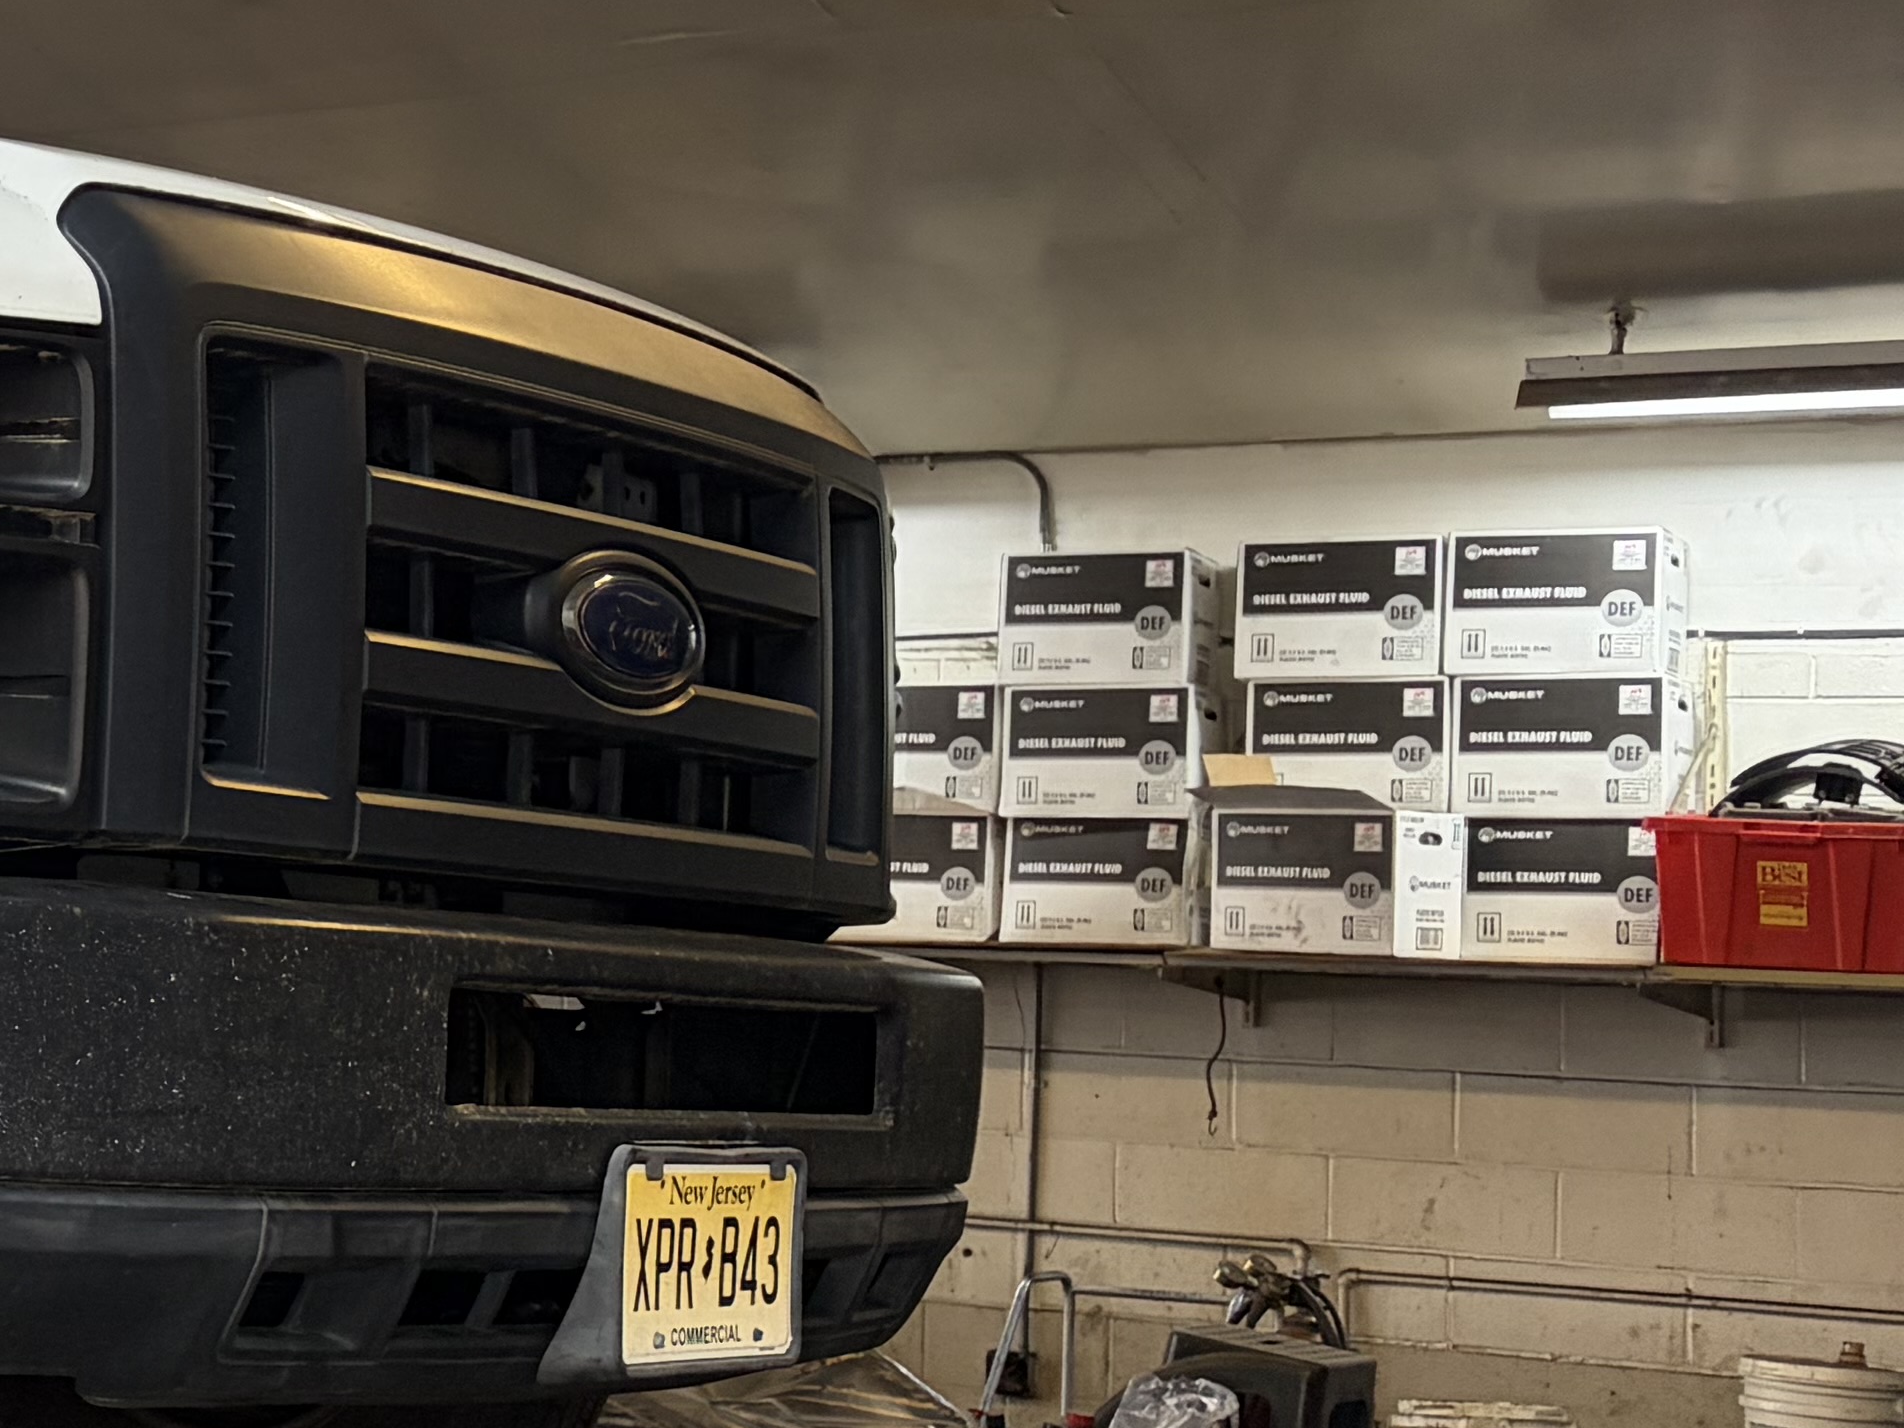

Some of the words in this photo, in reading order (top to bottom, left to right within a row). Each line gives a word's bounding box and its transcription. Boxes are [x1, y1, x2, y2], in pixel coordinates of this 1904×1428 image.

[1253, 594, 1287, 605] DIESEL
[1289, 592, 1336, 604] EXHAUST
[1338, 592, 1370, 603] FLUID
[1463, 588, 1499, 599] DIESEL
[1501, 587, 1552, 598] EXHAUST
[1553, 587, 1587, 598] FLUID
[1014, 604, 1045, 615] DIESEL
[1047, 603, 1092, 615] EXHAUST
[1094, 603, 1122, 614] FLUID
[1390, 605, 1418, 620] DEF
[1607, 601, 1636, 616] DEF
[1140, 616, 1165, 630] DEF
[909, 733, 936, 744] FLUID
[1018, 738, 1049, 749] DIESEL
[1051, 737, 1095, 748] EXHAUST
[1097, 737, 1126, 748] FLUID
[1262, 733, 1295, 745] DIESEL
[1298, 733, 1345, 745] EXHAUST
[1347, 733, 1379, 744] FLUID
[1469, 732, 1504, 743] DIESEL
[1507, 731, 1557, 743] EXHAUST
[1559, 731, 1593, 743] FLUID
[953, 747, 976, 761] DEF
[1144, 751, 1170, 765] DEF
[1398, 747, 1426, 762] DEF
[1614, 746, 1643, 761] DEF
[902, 862, 929, 873] FLUID
[1018, 863, 1048, 873] DIESEL
[1049, 863, 1093, 874] EXHAUST
[1094, 863, 1123, 874] FLUID
[1226, 866, 1255, 877] DIESEL
[1257, 866, 1300, 878] EXHAUST
[1302, 866, 1331, 879] FLUID
[946, 876, 969, 890] DEF
[1141, 877, 1167, 892] DEF
[1477, 871, 1513, 883] DIESEL
[1516, 872, 1567, 883] EXHAUST
[1568, 872, 1602, 884] FLUID
[1349, 883, 1375, 899] DEF
[1624, 888, 1654, 903] DEF
[669, 1176, 708, 1206] New
[707, 1176, 756, 1211] Jersey
[633, 1217, 697, 1312] XPR
[718, 1216, 780, 1308] B43
[670, 1325, 742, 1347] COMMERCIAL
